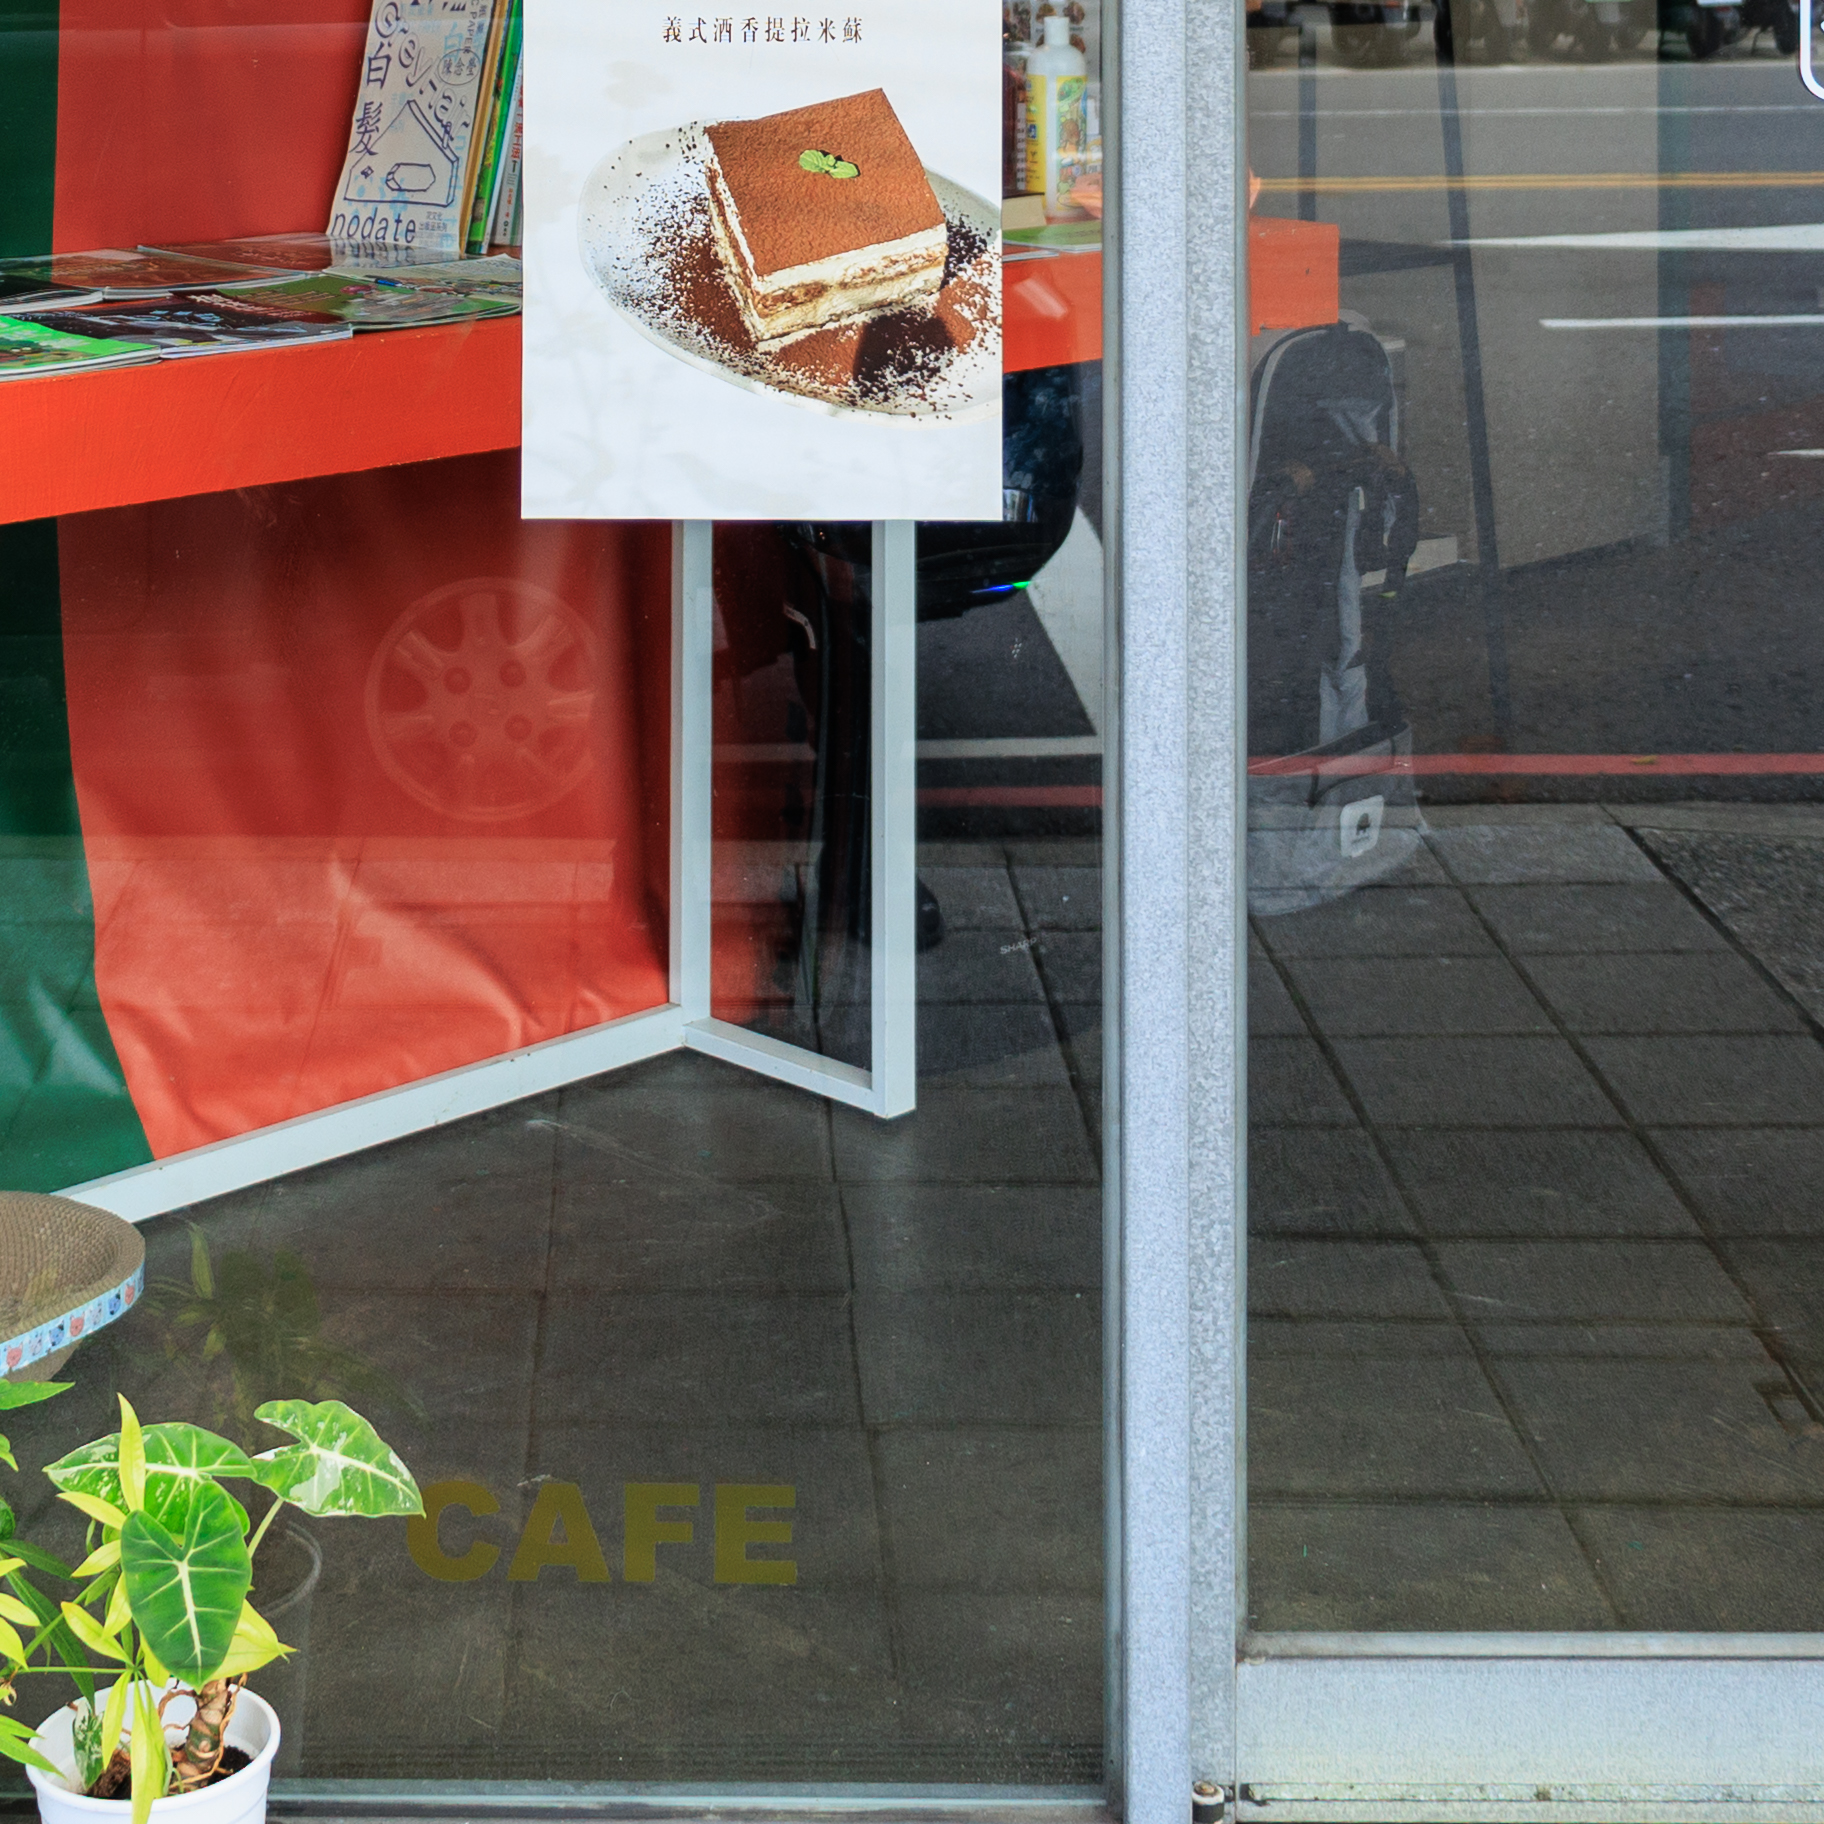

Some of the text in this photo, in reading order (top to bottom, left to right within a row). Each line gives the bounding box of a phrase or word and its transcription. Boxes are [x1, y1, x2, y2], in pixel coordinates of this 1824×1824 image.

[660, 15, 864, 45] 義式酒香提拉米蘇
[330, 211, 418, 243] nodate
[406, 1479, 798, 1585] CAFE
